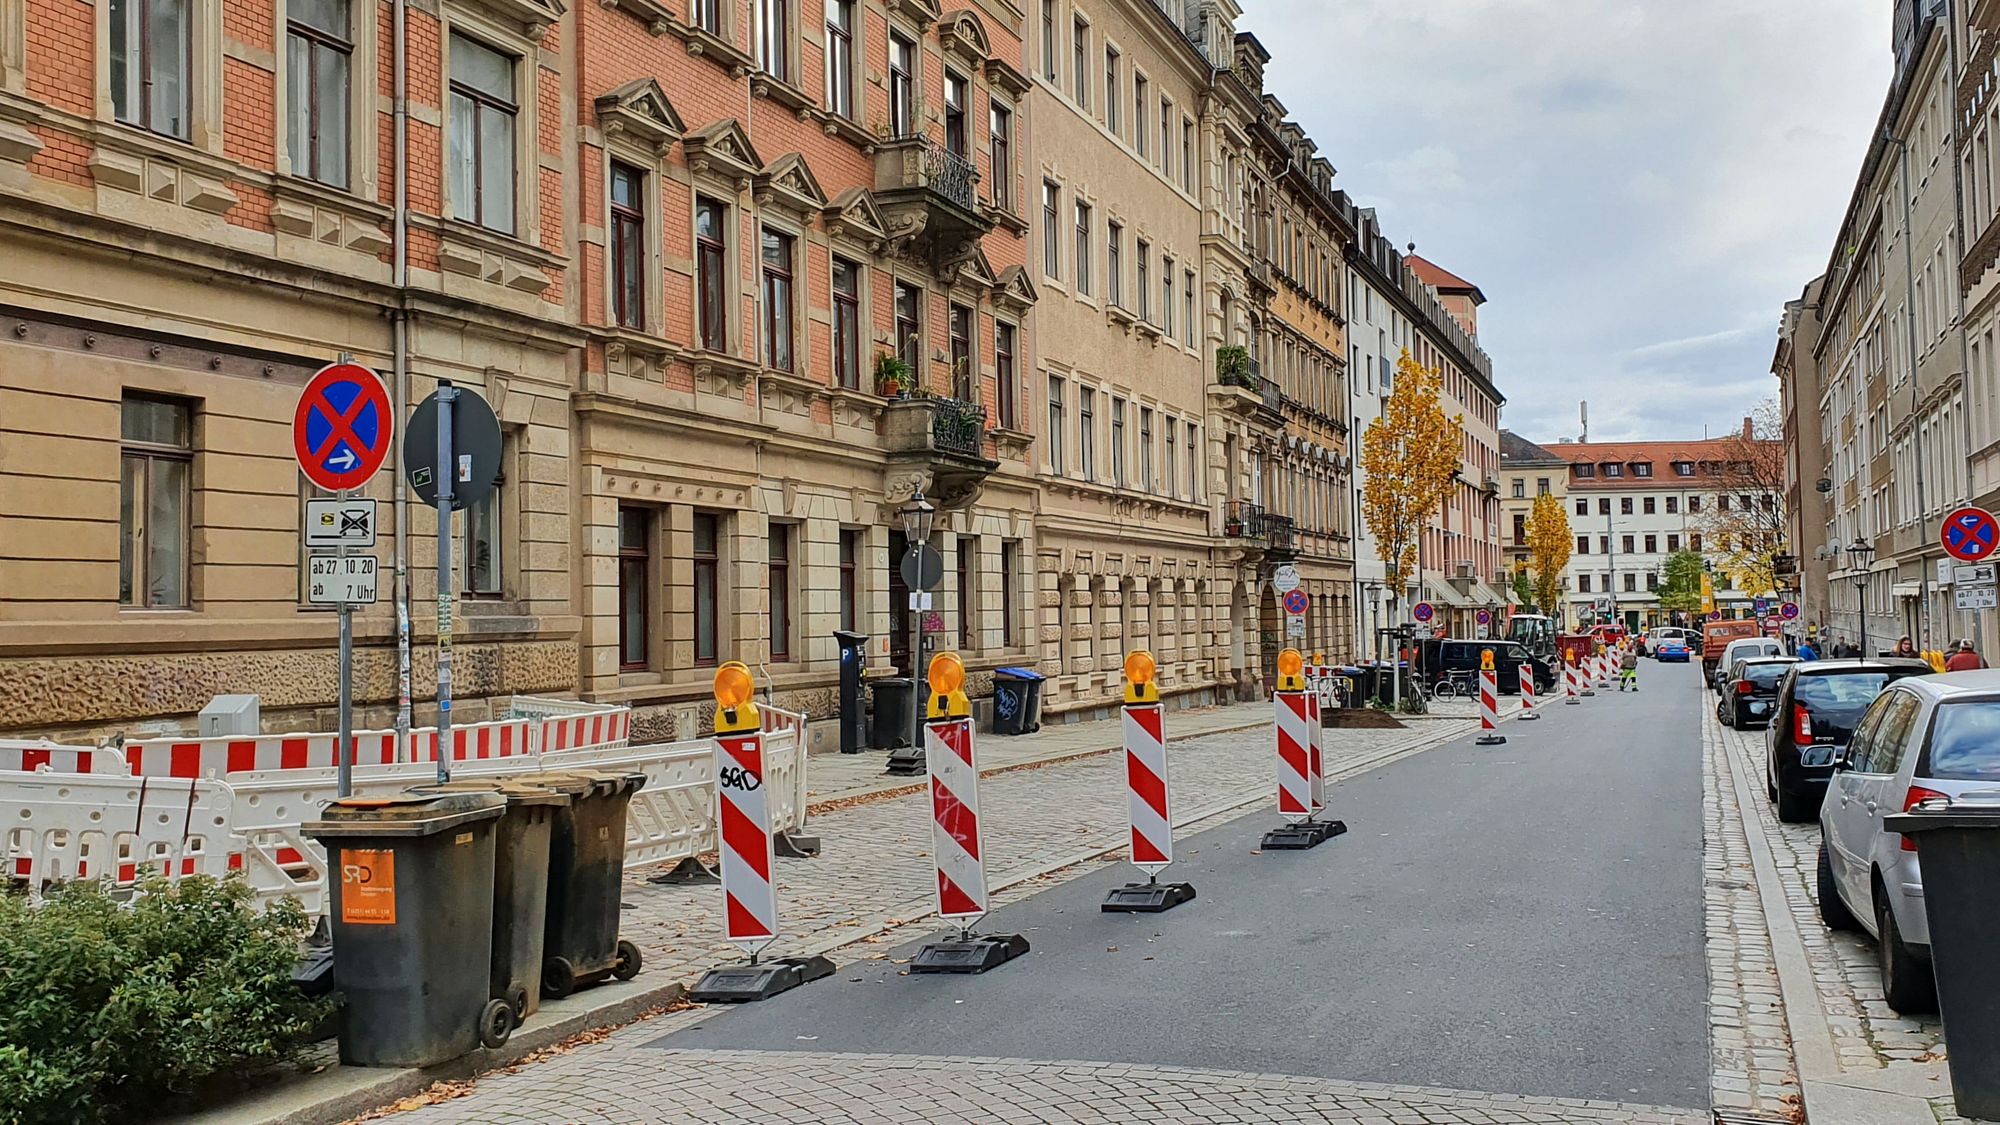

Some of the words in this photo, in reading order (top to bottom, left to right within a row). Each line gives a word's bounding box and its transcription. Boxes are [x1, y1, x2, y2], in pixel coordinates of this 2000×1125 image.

[313, 560, 324, 574] ab
[313, 582, 324, 595] ab
[347, 584, 353, 599] 7
[357, 584, 374, 599] Uhr
[842, 648, 850, 660] P
